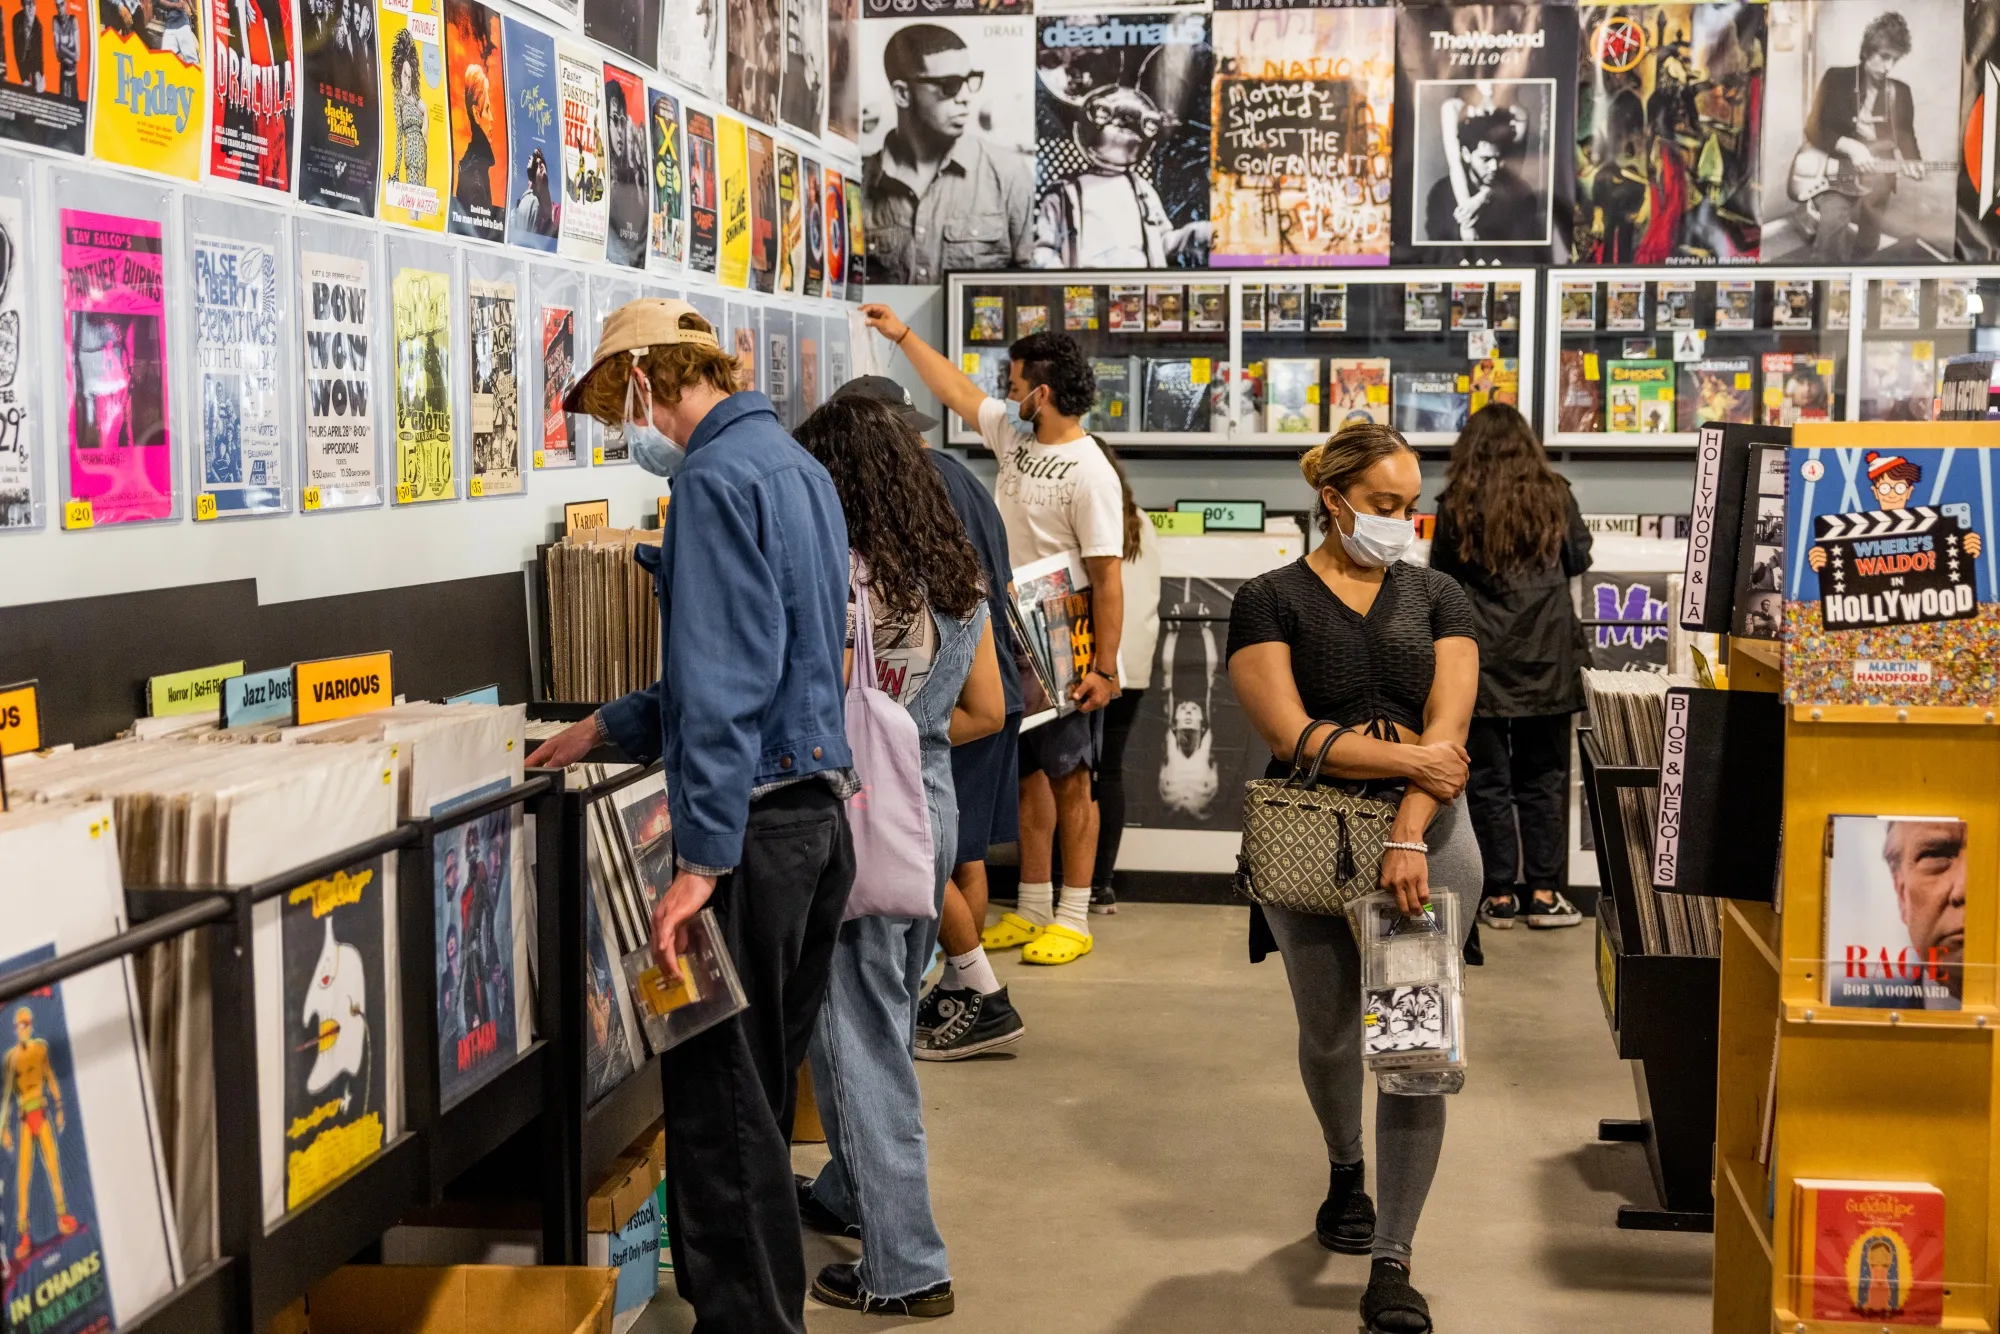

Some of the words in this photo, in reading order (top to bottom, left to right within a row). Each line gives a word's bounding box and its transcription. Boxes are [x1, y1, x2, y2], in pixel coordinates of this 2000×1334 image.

[983, 25, 1024, 38] DRAKE
[1043, 17, 1206, 48] deadmau5
[1449, 52, 1521, 66] TRILOGY
[113, 52, 194, 134] Friday
[214, 38, 294, 125] DRACULA
[324, 98, 354, 123] Jackie
[564, 99, 588, 125] KILL!
[327, 117, 360, 146] Brown
[1224, 128, 1296, 149] TRUST
[1299, 129, 1339, 153] THE
[1234, 153, 1367, 178] GOVERNMENT
[452, 212, 461, 222] The
[462, 216, 473, 225] man
[493, 219, 504, 231] Earth
[1300, 206, 1382, 241] FLOYD
[68, 258, 117, 300] PANTHER
[123, 256, 162, 303] BURNS
[195, 249, 237, 285] FALSE
[196, 276, 259, 309] LIBERTY
[312, 282, 366, 324] BOW
[307, 330, 368, 372] WOW
[1614, 367, 1666, 381] SHOCK
[307, 378, 367, 417] WOW
[308, 425, 326, 437] THURS
[328, 425, 342, 437] APRIL
[411, 411, 450, 433] GROTUS
[322, 442, 359, 455] HIPPODROME
[416, 430, 437, 443] MARCH
[253, 461, 265, 472] ALL
[1808, 464, 1817, 476] 4
[1694, 432, 1719, 564] HOLLYWOOD
[1204, 507, 1235, 521] 90's
[1852, 535, 1934, 558] WHERE'S
[1691, 571, 1704, 584] &
[1855, 553, 1936, 577] WALDO?
[1891, 577, 1904, 587] IN
[1687, 591, 1701, 620] LA
[1826, 584, 1974, 624] HOLLYWOOD
[1857, 671, 1929, 684] HANDFORD
[1868, 661, 1919, 673] MARTIN
[167, 682, 191, 703] Horror
[195, 679, 211, 699] Sci-Fi
[243, 682, 266, 708] Jazz
[312, 674, 380, 703] VARIOUS
[1667, 697, 1686, 754] BIOS
[1665, 761, 1681, 776] &
[1658, 782, 1682, 882] MEMOIRS
[1845, 944, 1949, 982] RAGE
[1842, 982, 1870, 998] BOB
[1873, 983, 1949, 1000] WOODWARD
[457, 1019, 497, 1071] ANT-MAN
[612, 1247, 628, 1268] Staff
[629, 1243, 642, 1262] Only
[642, 1237, 659, 1255] Please
[10, 1293, 32, 1326] IN
[35, 1251, 100, 1308] CHAINS
